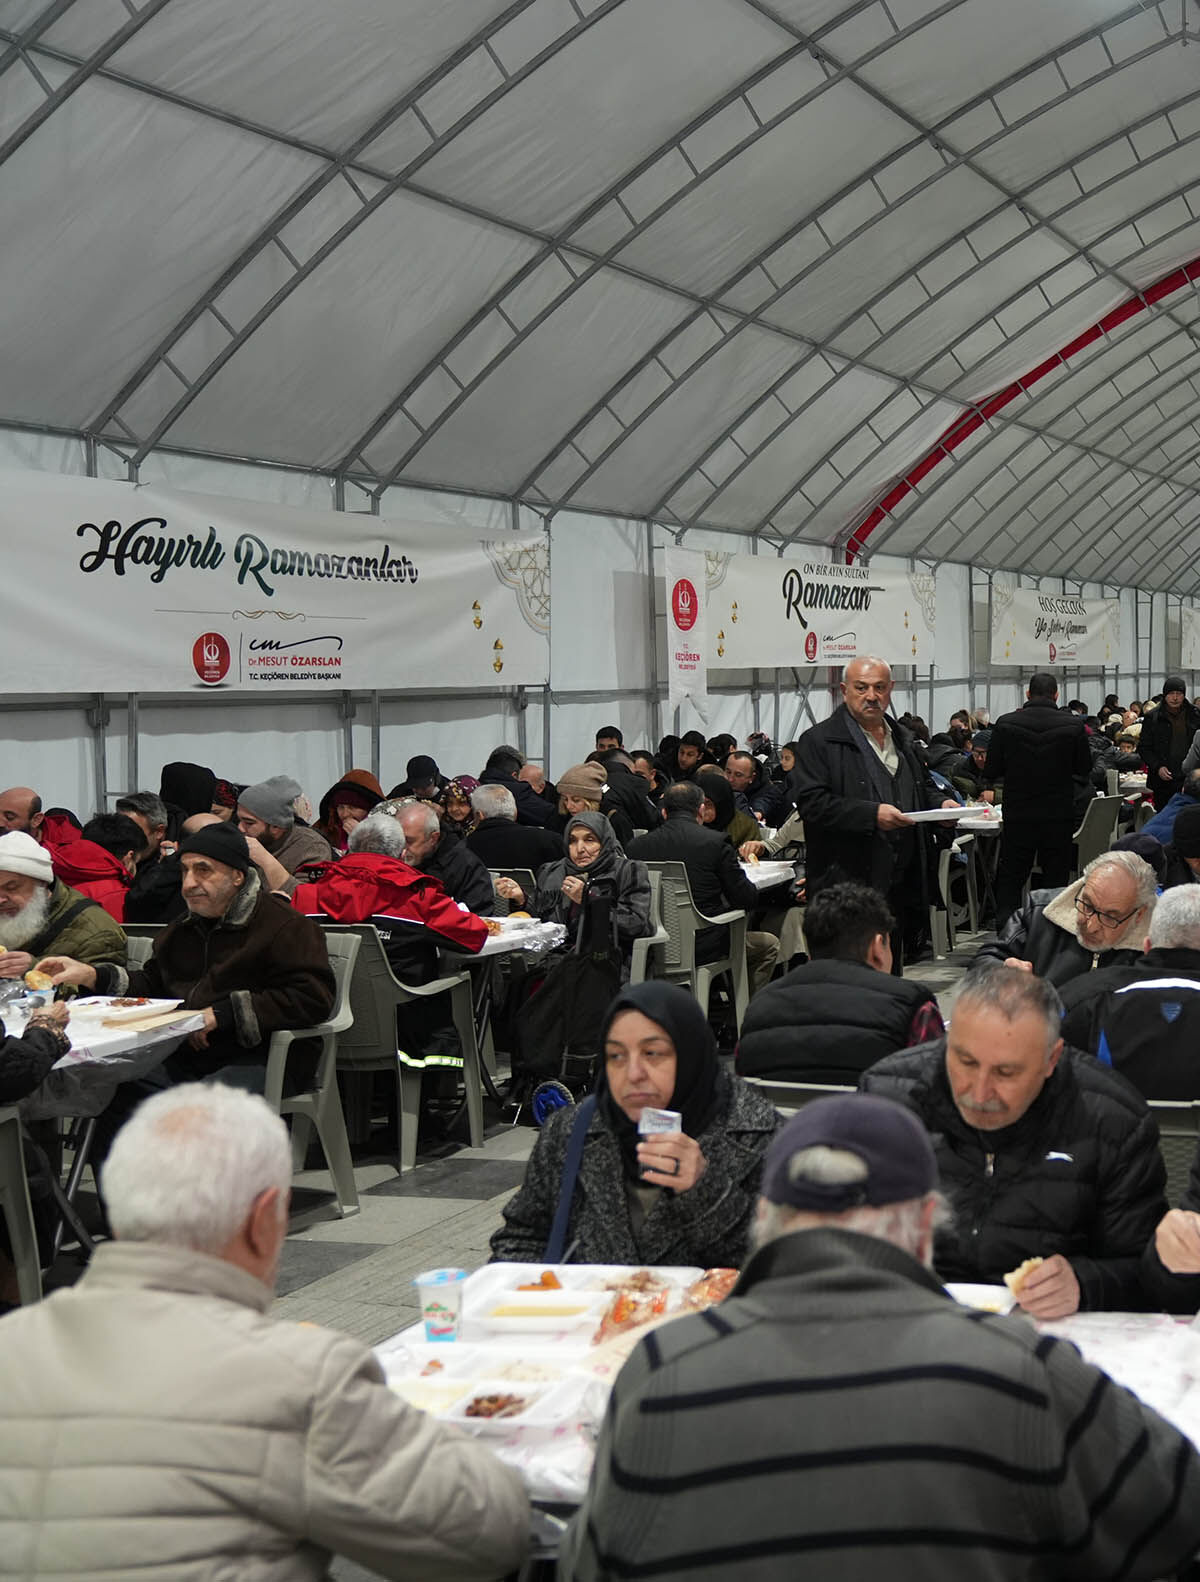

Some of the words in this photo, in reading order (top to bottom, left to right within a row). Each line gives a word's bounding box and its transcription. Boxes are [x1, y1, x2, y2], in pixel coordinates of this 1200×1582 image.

[76, 517, 226, 584] Hayırlı
[233, 533, 419, 597] Ramazanlar
[803, 563, 816, 575] ON
[782, 568, 886, 630] Ramazan
[291, 655, 342, 666] ÖZARSLAN
[260, 672, 289, 682] KEÇİÖREN
